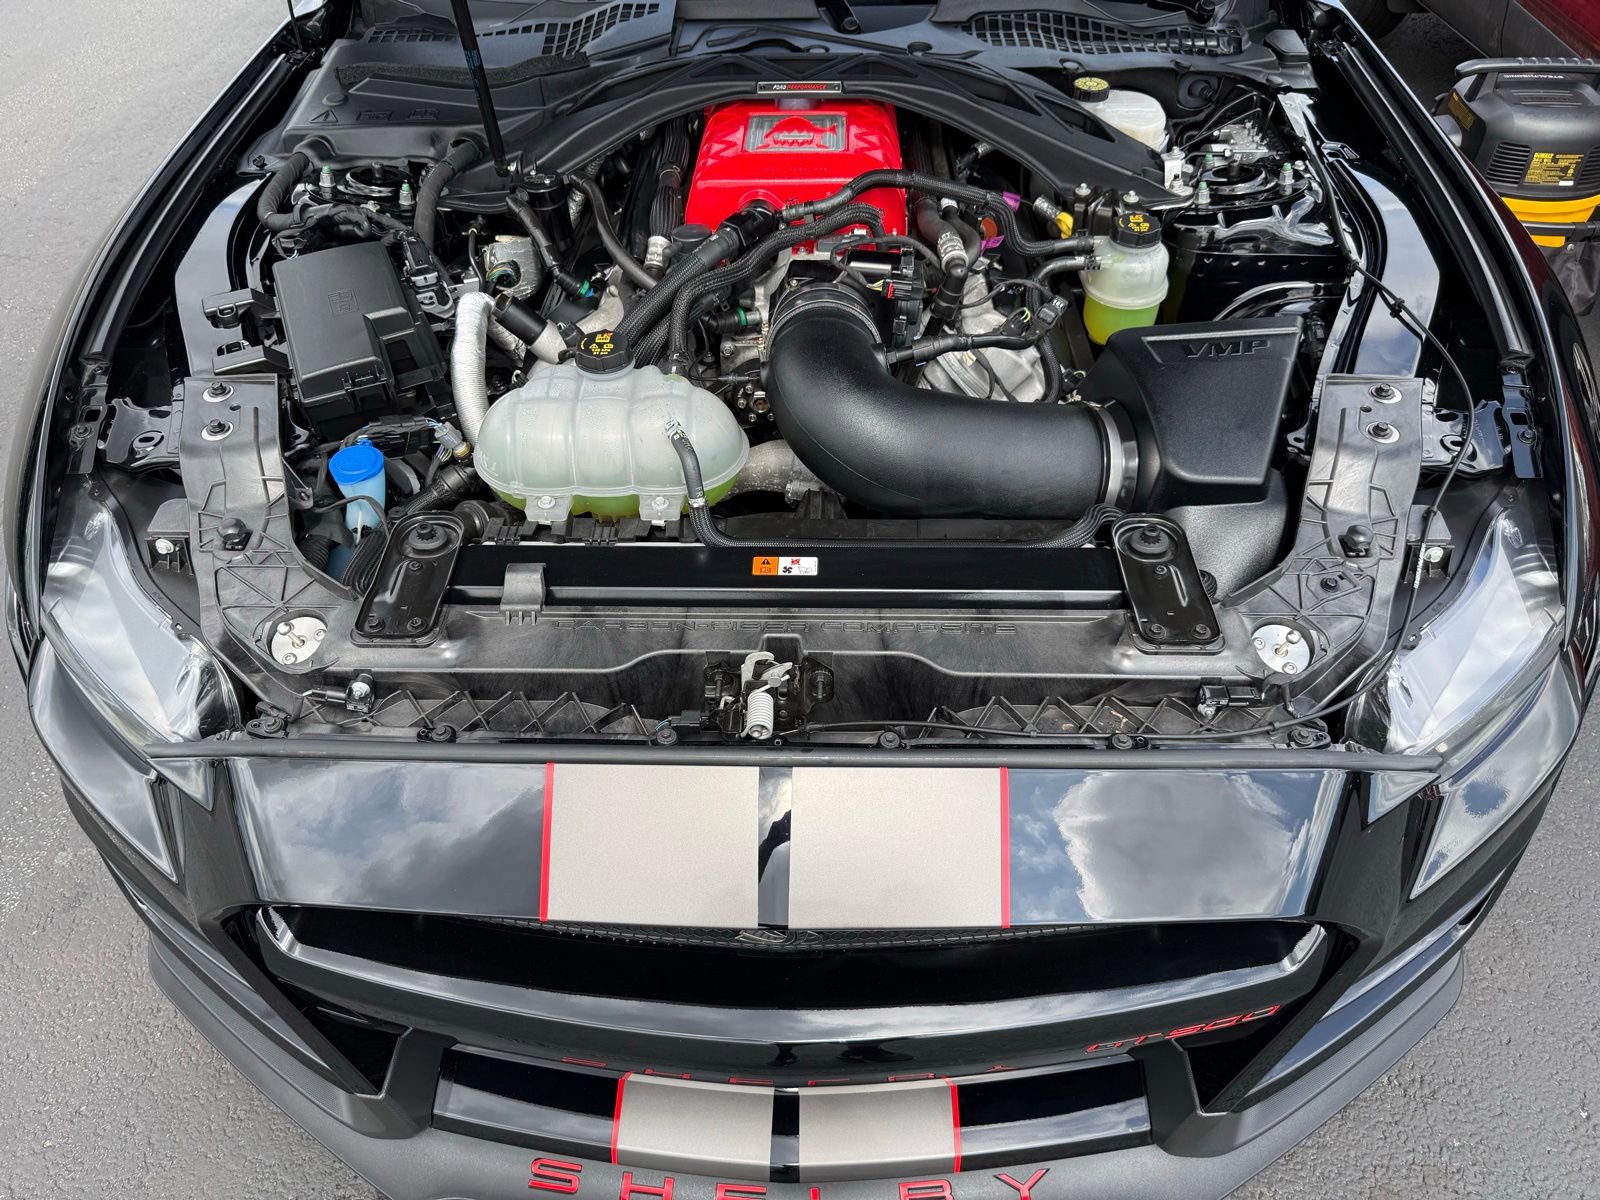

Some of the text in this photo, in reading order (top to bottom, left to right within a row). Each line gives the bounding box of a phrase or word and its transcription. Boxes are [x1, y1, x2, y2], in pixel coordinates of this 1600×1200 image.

[1182, 339, 1271, 358] VMP
[555, 619, 1018, 635] CARBON-FIBER COMPOSITE
